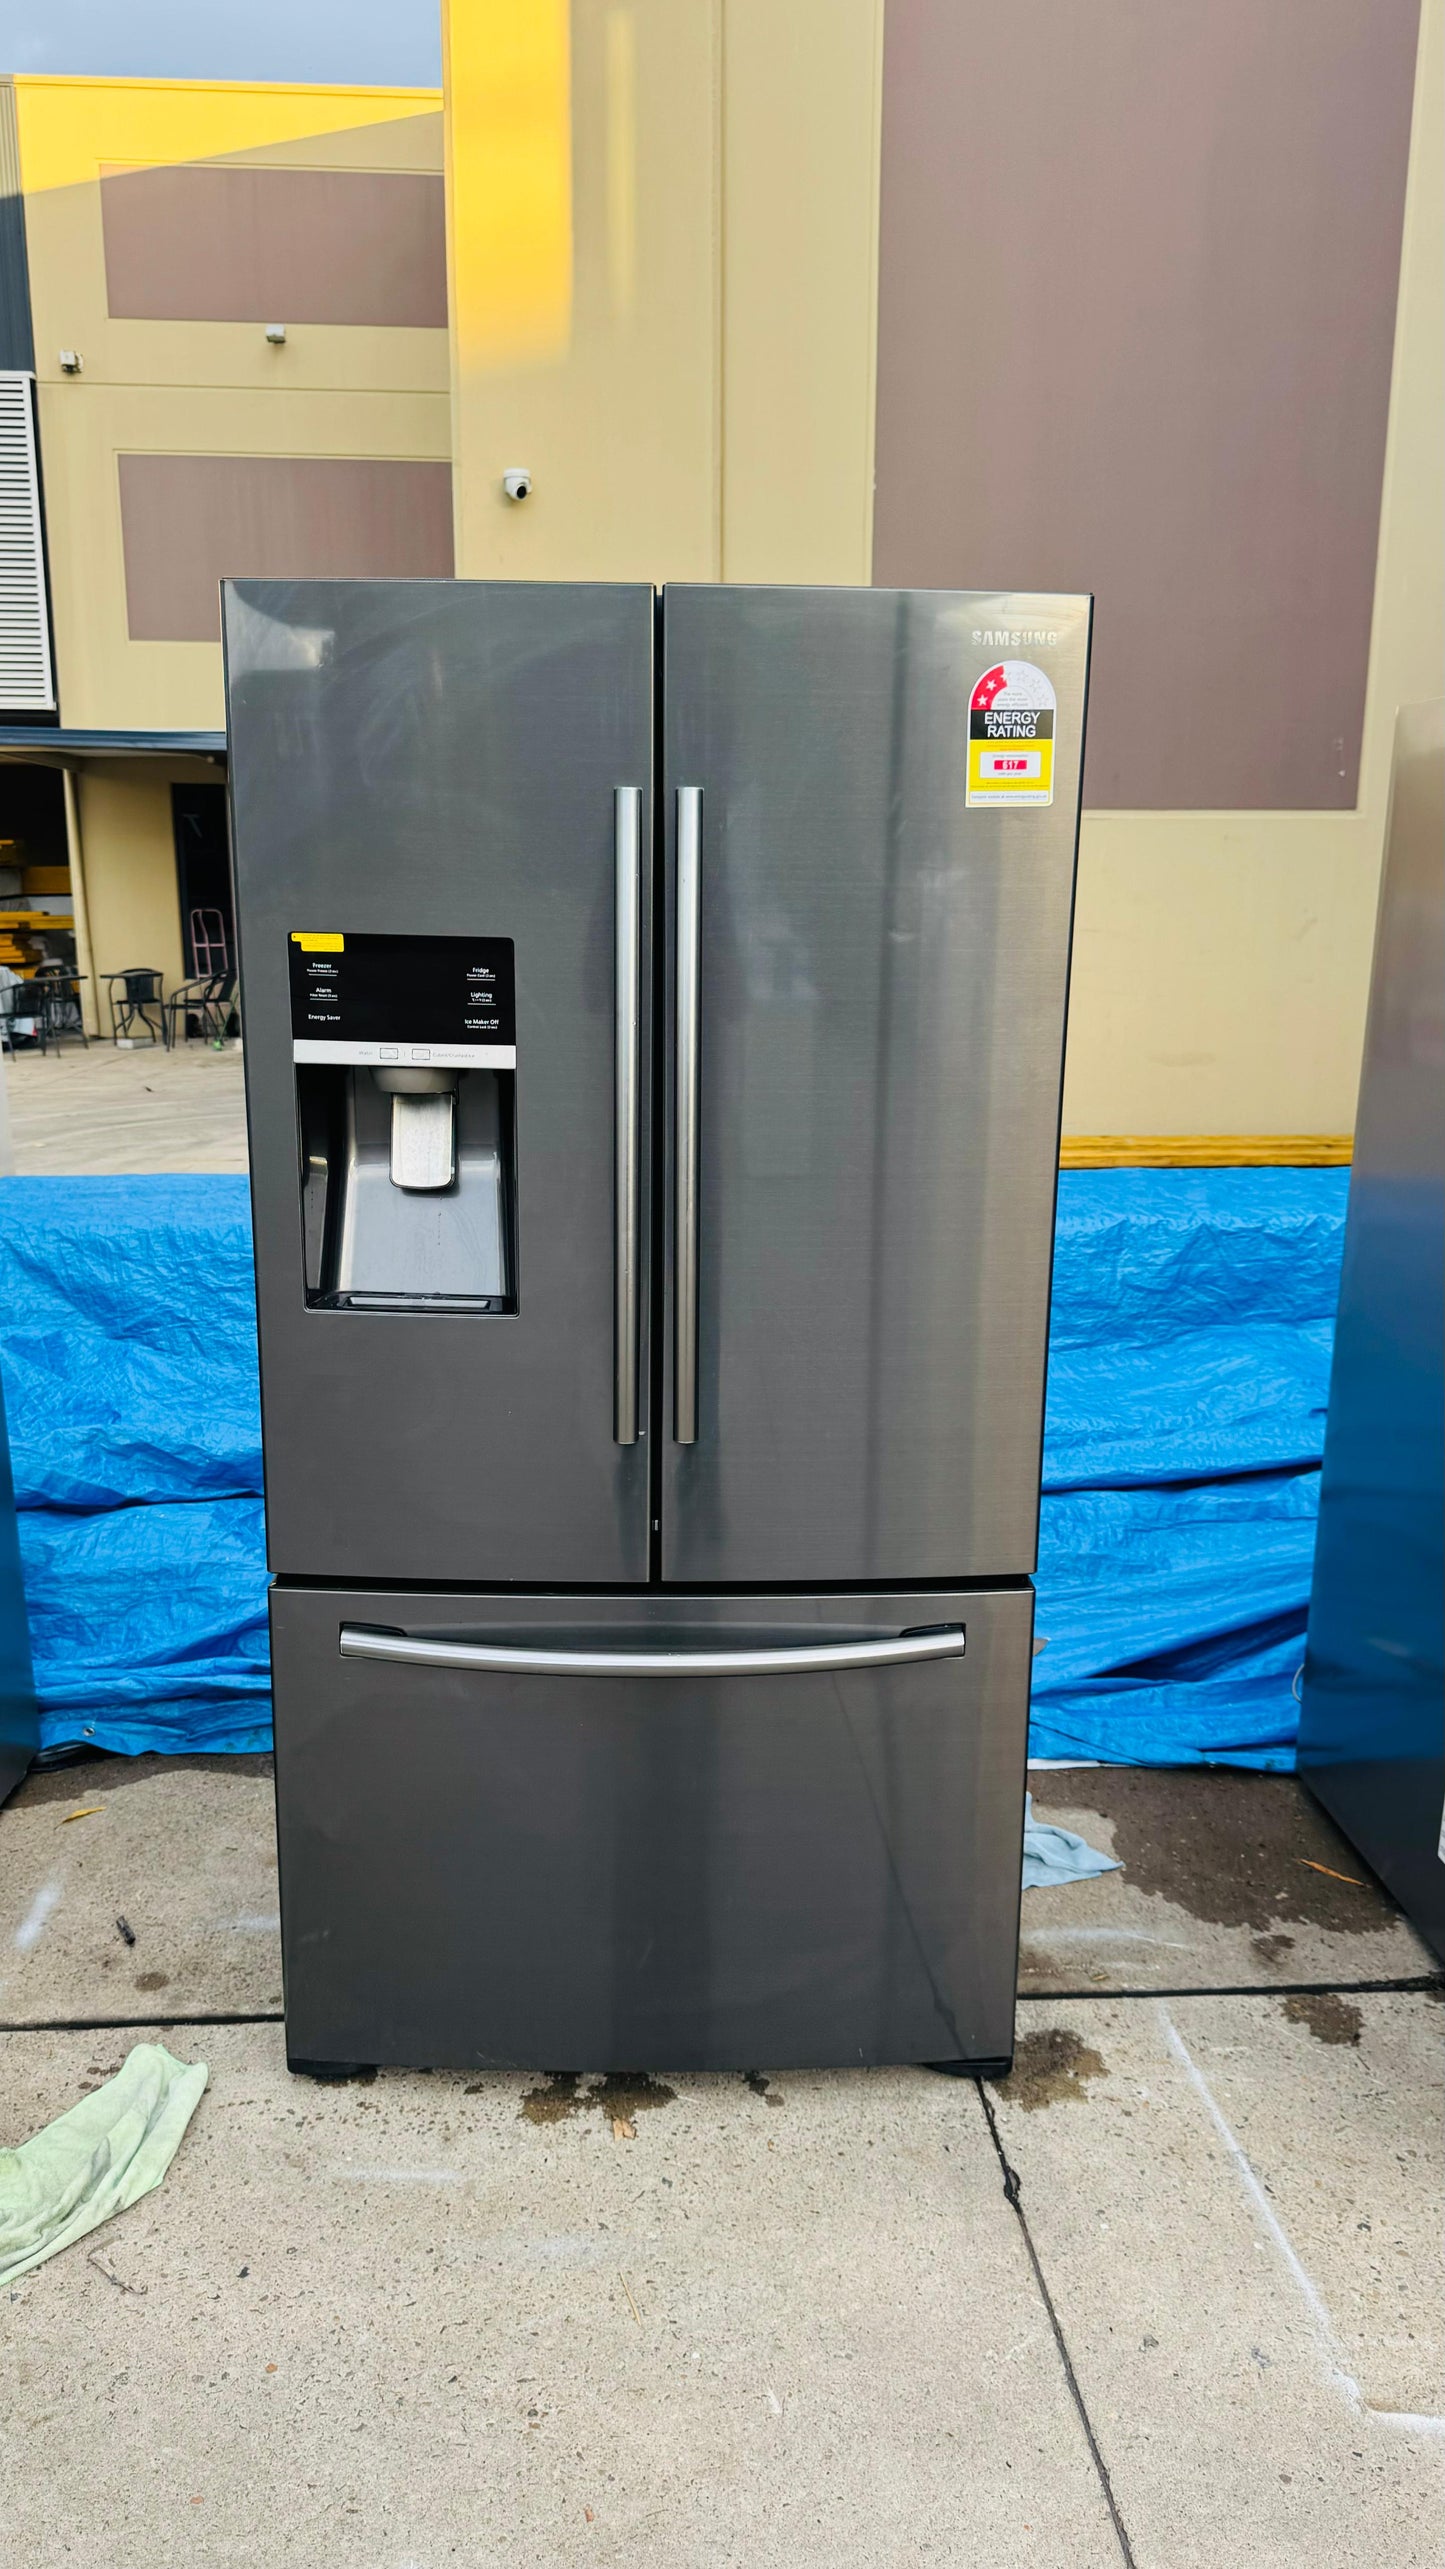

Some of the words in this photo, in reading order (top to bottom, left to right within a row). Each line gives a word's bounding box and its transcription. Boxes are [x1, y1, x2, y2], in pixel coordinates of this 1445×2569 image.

[972, 630, 1057, 646] SAMSUNG
[984, 712, 1040, 724] ENERGY
[987, 725, 1036, 737] RATING
[1002, 760, 1019, 769] 617
